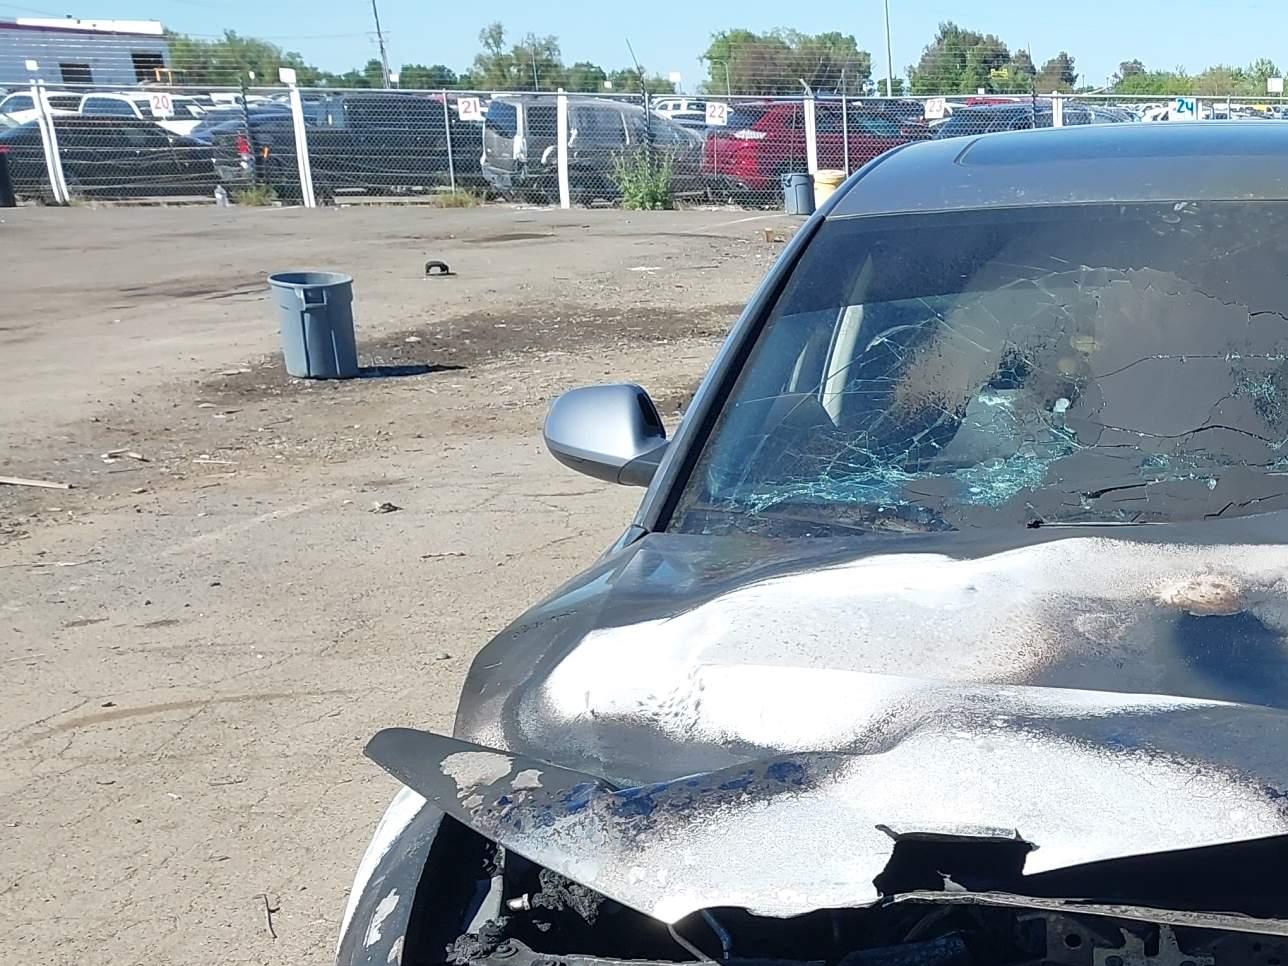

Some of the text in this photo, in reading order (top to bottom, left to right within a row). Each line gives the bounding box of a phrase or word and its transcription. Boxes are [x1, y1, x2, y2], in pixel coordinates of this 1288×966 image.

[153, 96, 169, 110] 20
[462, 100, 478, 113] 21
[929, 100, 943, 112] 23
[1177, 99, 1194, 116] 24
[709, 104, 725, 118] 22
